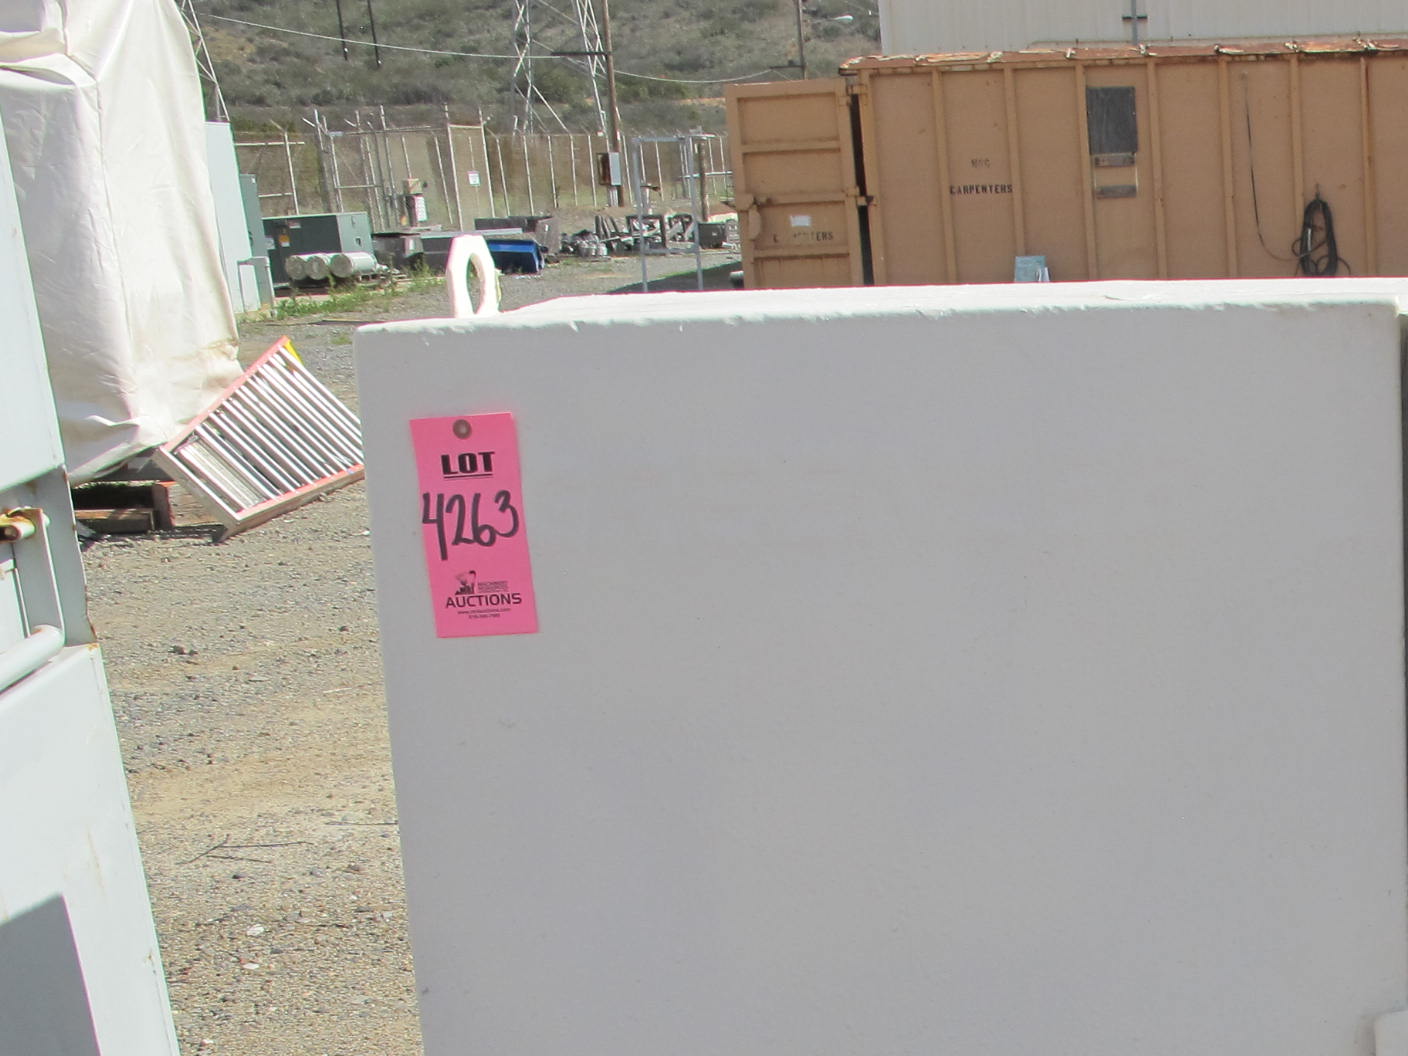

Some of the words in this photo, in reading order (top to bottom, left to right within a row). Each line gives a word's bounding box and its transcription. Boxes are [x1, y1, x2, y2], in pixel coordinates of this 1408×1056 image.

[949, 183, 1013, 195] CARPENTERS
[441, 451, 495, 475] LOT
[422, 490, 519, 561] 4263
[446, 593, 522, 608] AUCTIONS
